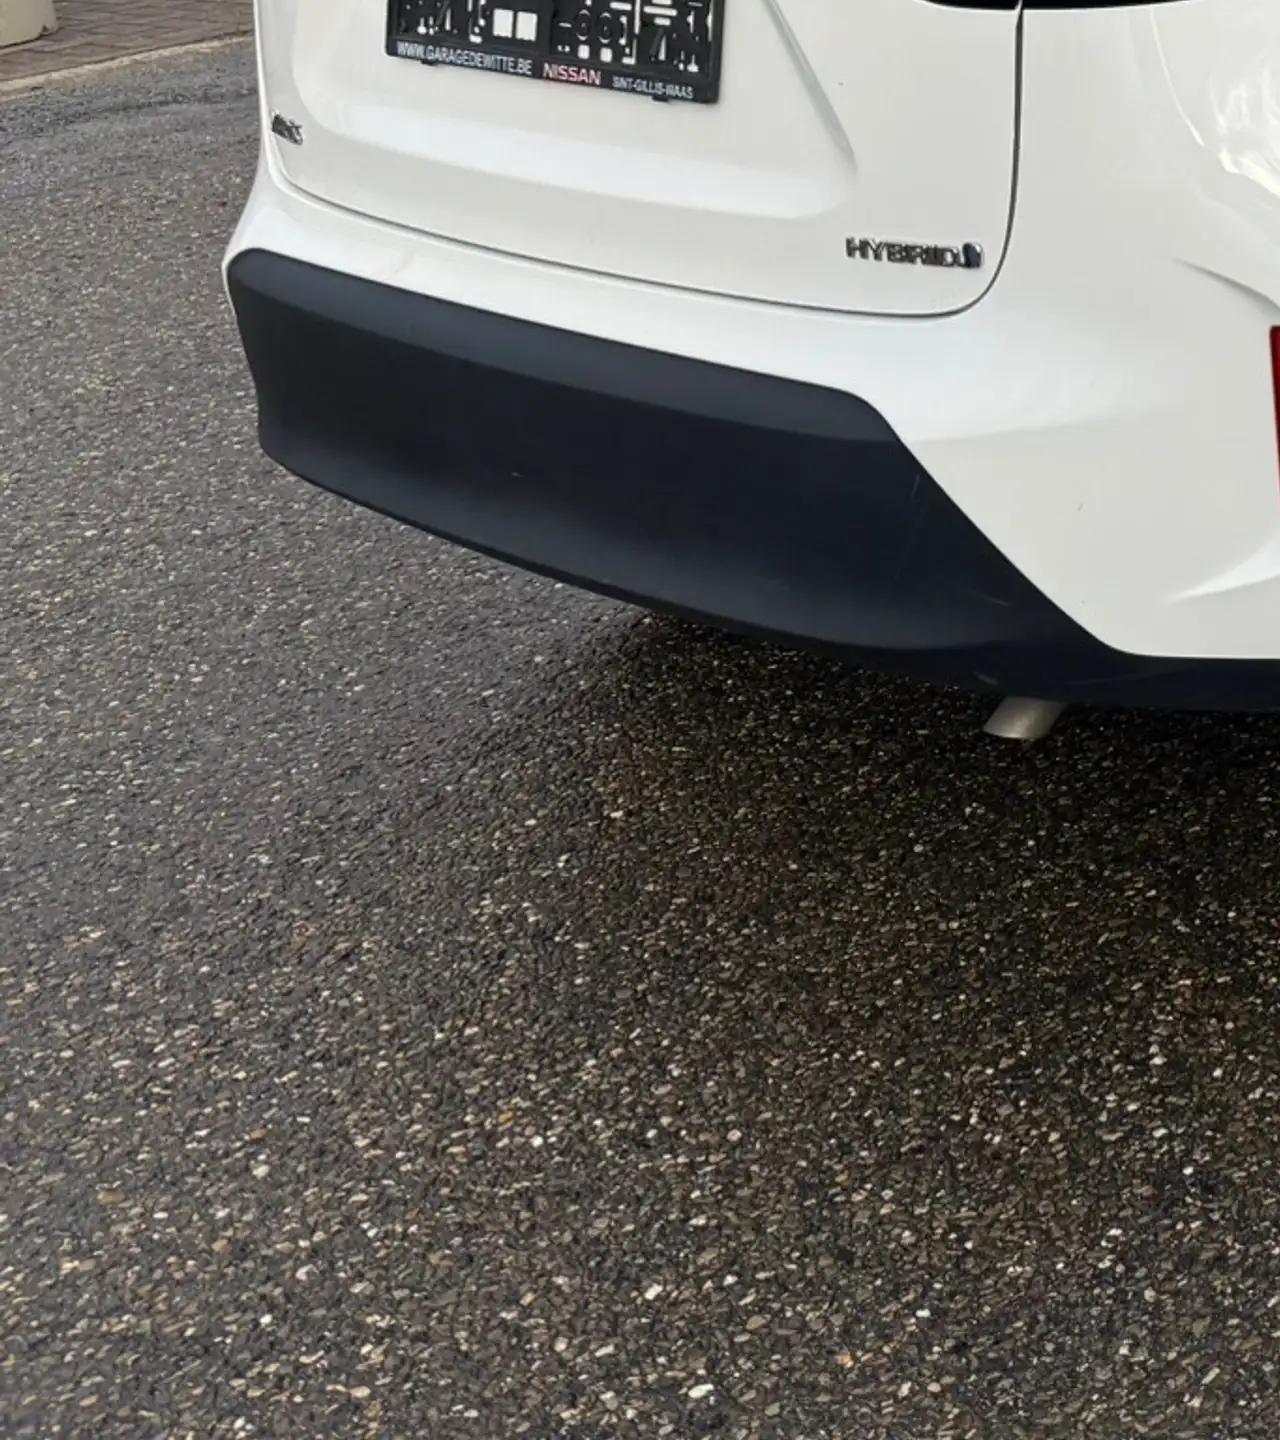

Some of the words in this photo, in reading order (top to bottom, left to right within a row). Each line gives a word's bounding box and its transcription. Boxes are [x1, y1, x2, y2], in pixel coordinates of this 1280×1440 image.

[396, 40, 533, 76] WWW.GARAGEDEWITTE.BE
[542, 61, 601, 86] NISSAN
[845, 236, 961, 268] HYBRID
